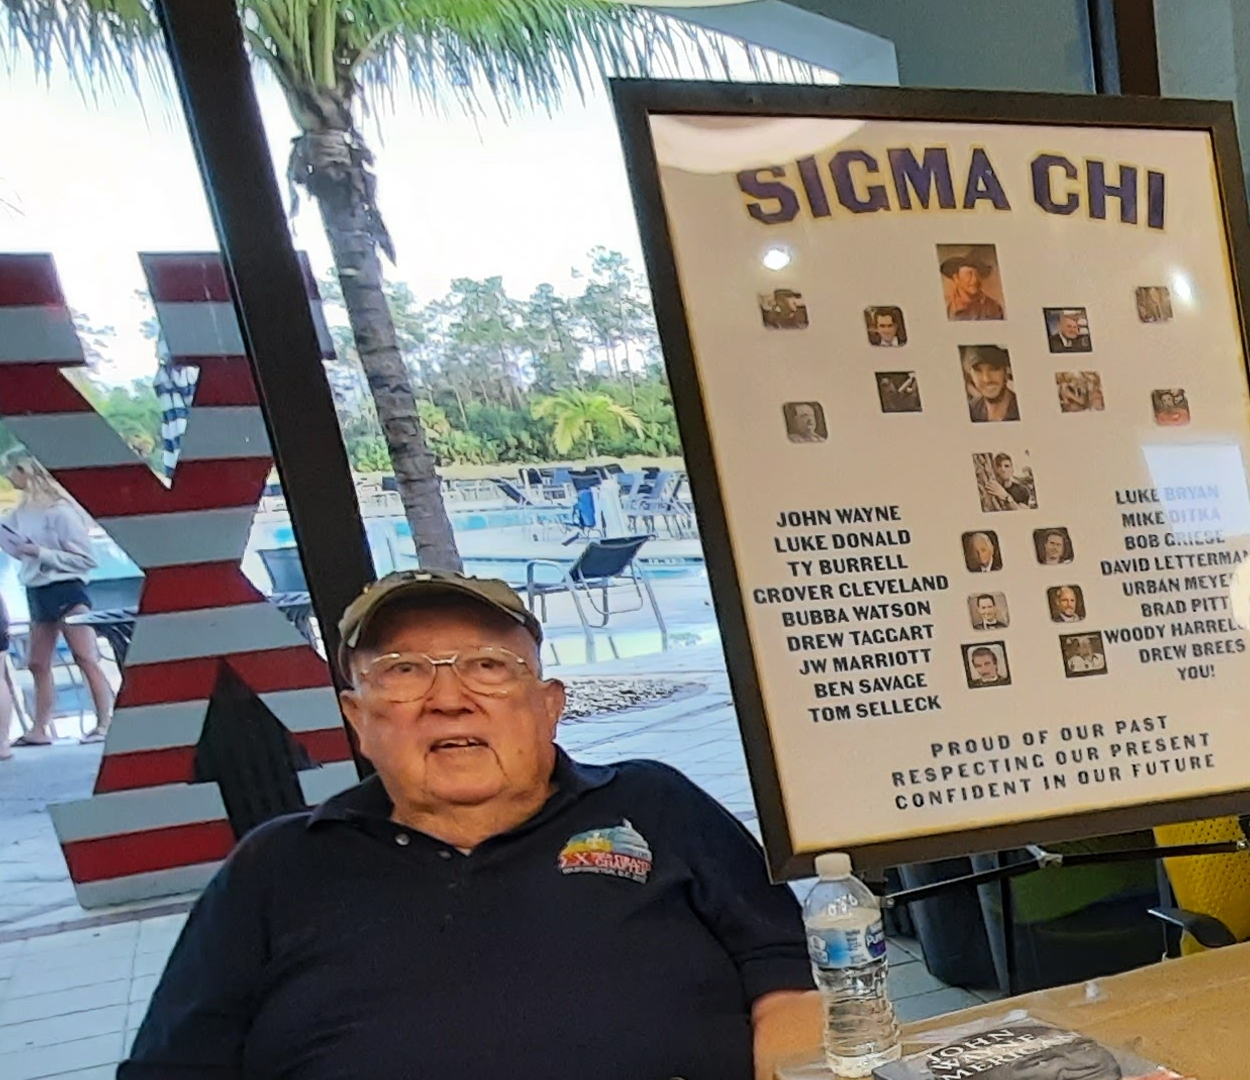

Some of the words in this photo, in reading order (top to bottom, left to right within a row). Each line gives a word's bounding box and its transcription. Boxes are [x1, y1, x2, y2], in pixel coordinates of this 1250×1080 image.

[737, 145, 1011, 226] SIGMA
[1029, 151, 1166, 230] CHI
[1115, 488, 1160, 505] LUKE
[1163, 485, 1220, 501] BRYAN
[776, 509, 832, 528] JOHN
[835, 505, 902, 524] WAYNE
[1122, 511, 1165, 528] MIKE
[1169, 508, 1221, 524] DITKA
[774, 534, 829, 553] LUKE
[832, 529, 912, 549] DONALD
[1124, 534, 1160, 550] BOB
[787, 560, 813, 577] TY
[819, 554, 909, 575] BURRELL
[1100, 558, 1150, 576] DAVID
[753, 583, 834, 604] GROVER
[839, 575, 950, 598] CLEVELAND
[1122, 578, 1180, 597] URBAN
[782, 608, 850, 627] BUBBA
[852, 600, 932, 622] WATSON
[1141, 600, 1187, 617] BRAD
[1191, 596, 1229, 613] PITT
[787, 632, 844, 652] DREW
[849, 624, 934, 646] TAGGART
[1104, 625, 1165, 645] WOODY
[799, 658, 827, 676] JW
[833, 648, 932, 673] MARRIOTT
[1139, 645, 1187, 664] DREW
[1192, 639, 1246, 658] BREES
[1177, 665, 1216, 681] YOU!
[814, 681, 855, 699] BEN
[859, 673, 928, 694] SAVAGE
[808, 705, 852, 723] TOM
[856, 695, 942, 719] SELLECK
[931, 735, 1011, 758] PROUD
[1022, 730, 1049, 746] OF
[1060, 723, 1105, 742] OUR
[1115, 715, 1169, 735] PAST
[892, 753, 1045, 788] RESPECTING
[1056, 747, 1100, 765] OUR
[1110, 732, 1211, 758] PRESENT
[895, 778, 1032, 810] CONFIDENT
[1043, 774, 1067, 790] IN
[1077, 766, 1122, 785] OUR
[1132, 754, 1216, 778] FUTURE
[927, 1028, 1015, 1064] JOHN
[932, 1034, 1034, 1070] WAYNE
